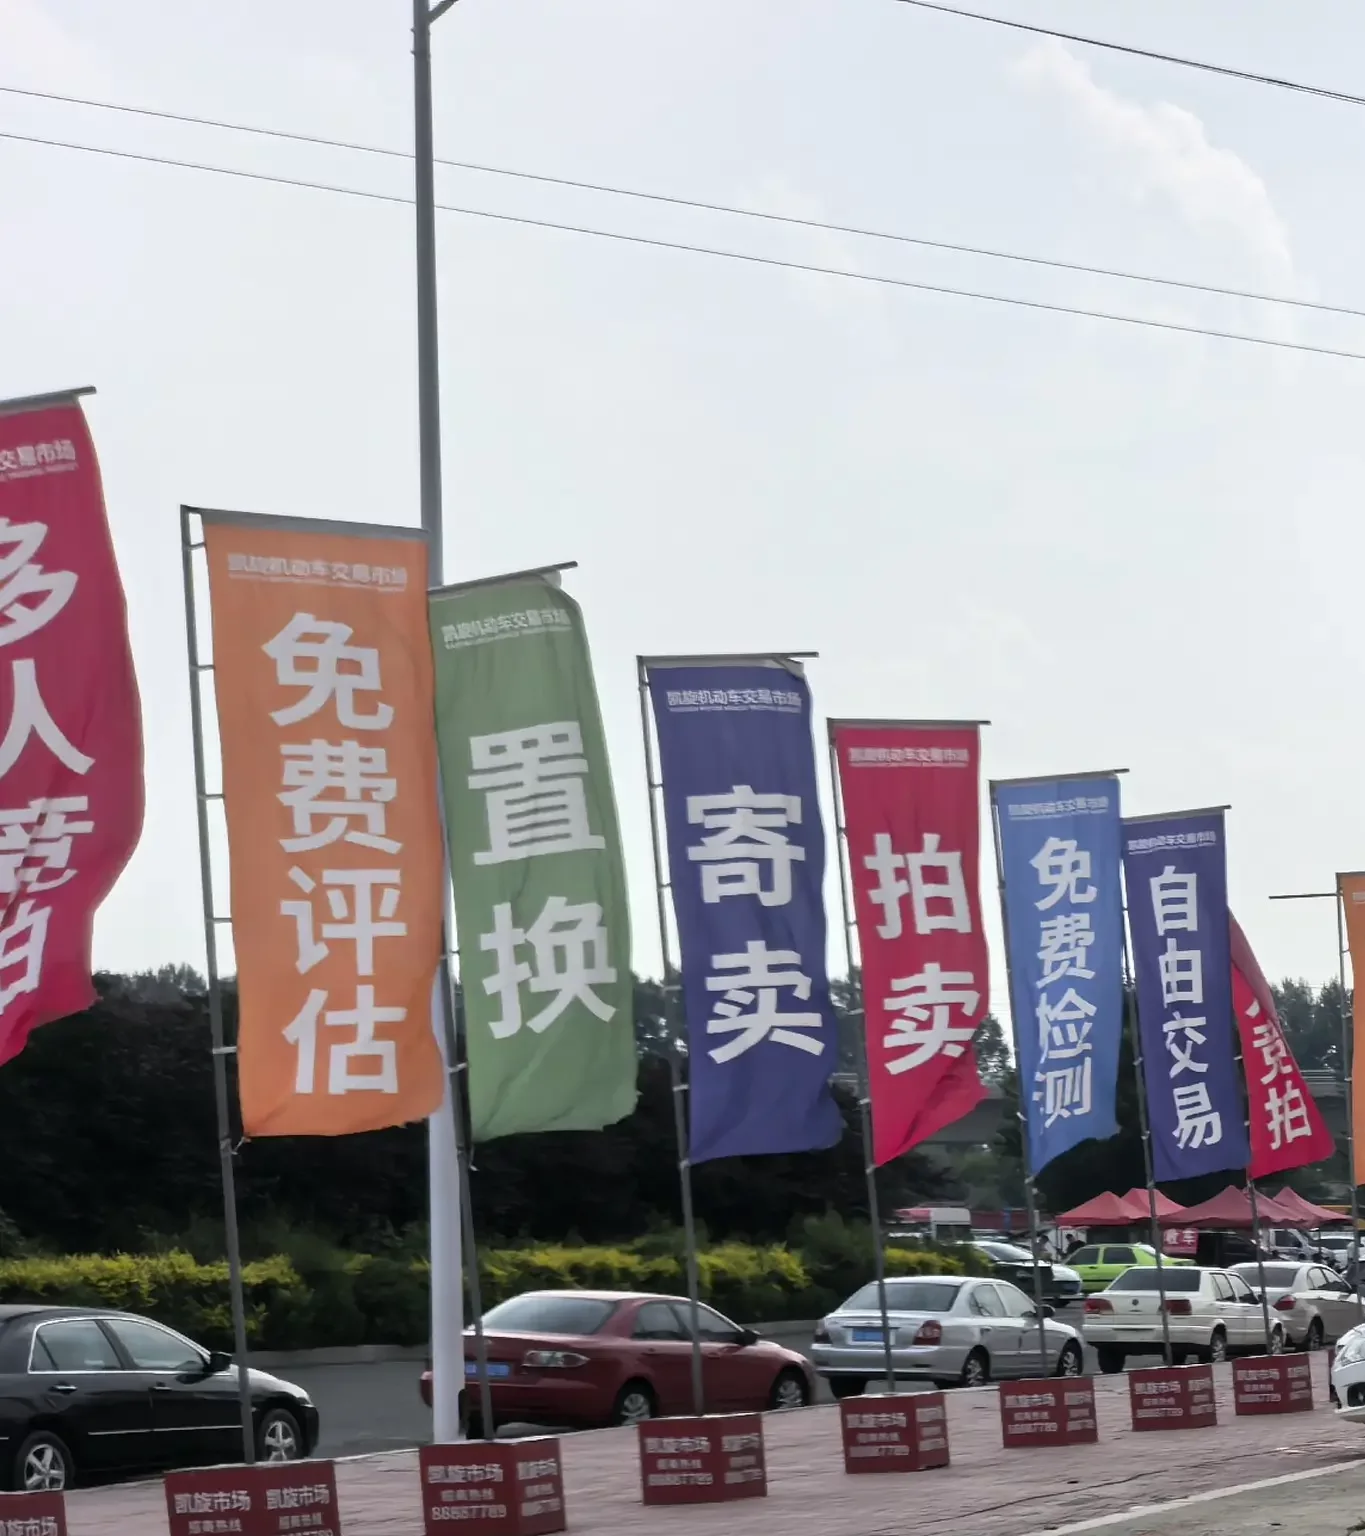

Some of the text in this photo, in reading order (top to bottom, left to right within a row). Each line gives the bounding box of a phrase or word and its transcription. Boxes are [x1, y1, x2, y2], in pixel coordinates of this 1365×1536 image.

[259, 611, 407, 1095] 免费评估
[467, 721, 618, 1040] 置换
[685, 784, 825, 1066] 寄卖
[863, 832, 981, 1076] 拍卖
[1029, 836, 1098, 1135] 免费检测
[1149, 864, 1223, 1150] 自由交易
